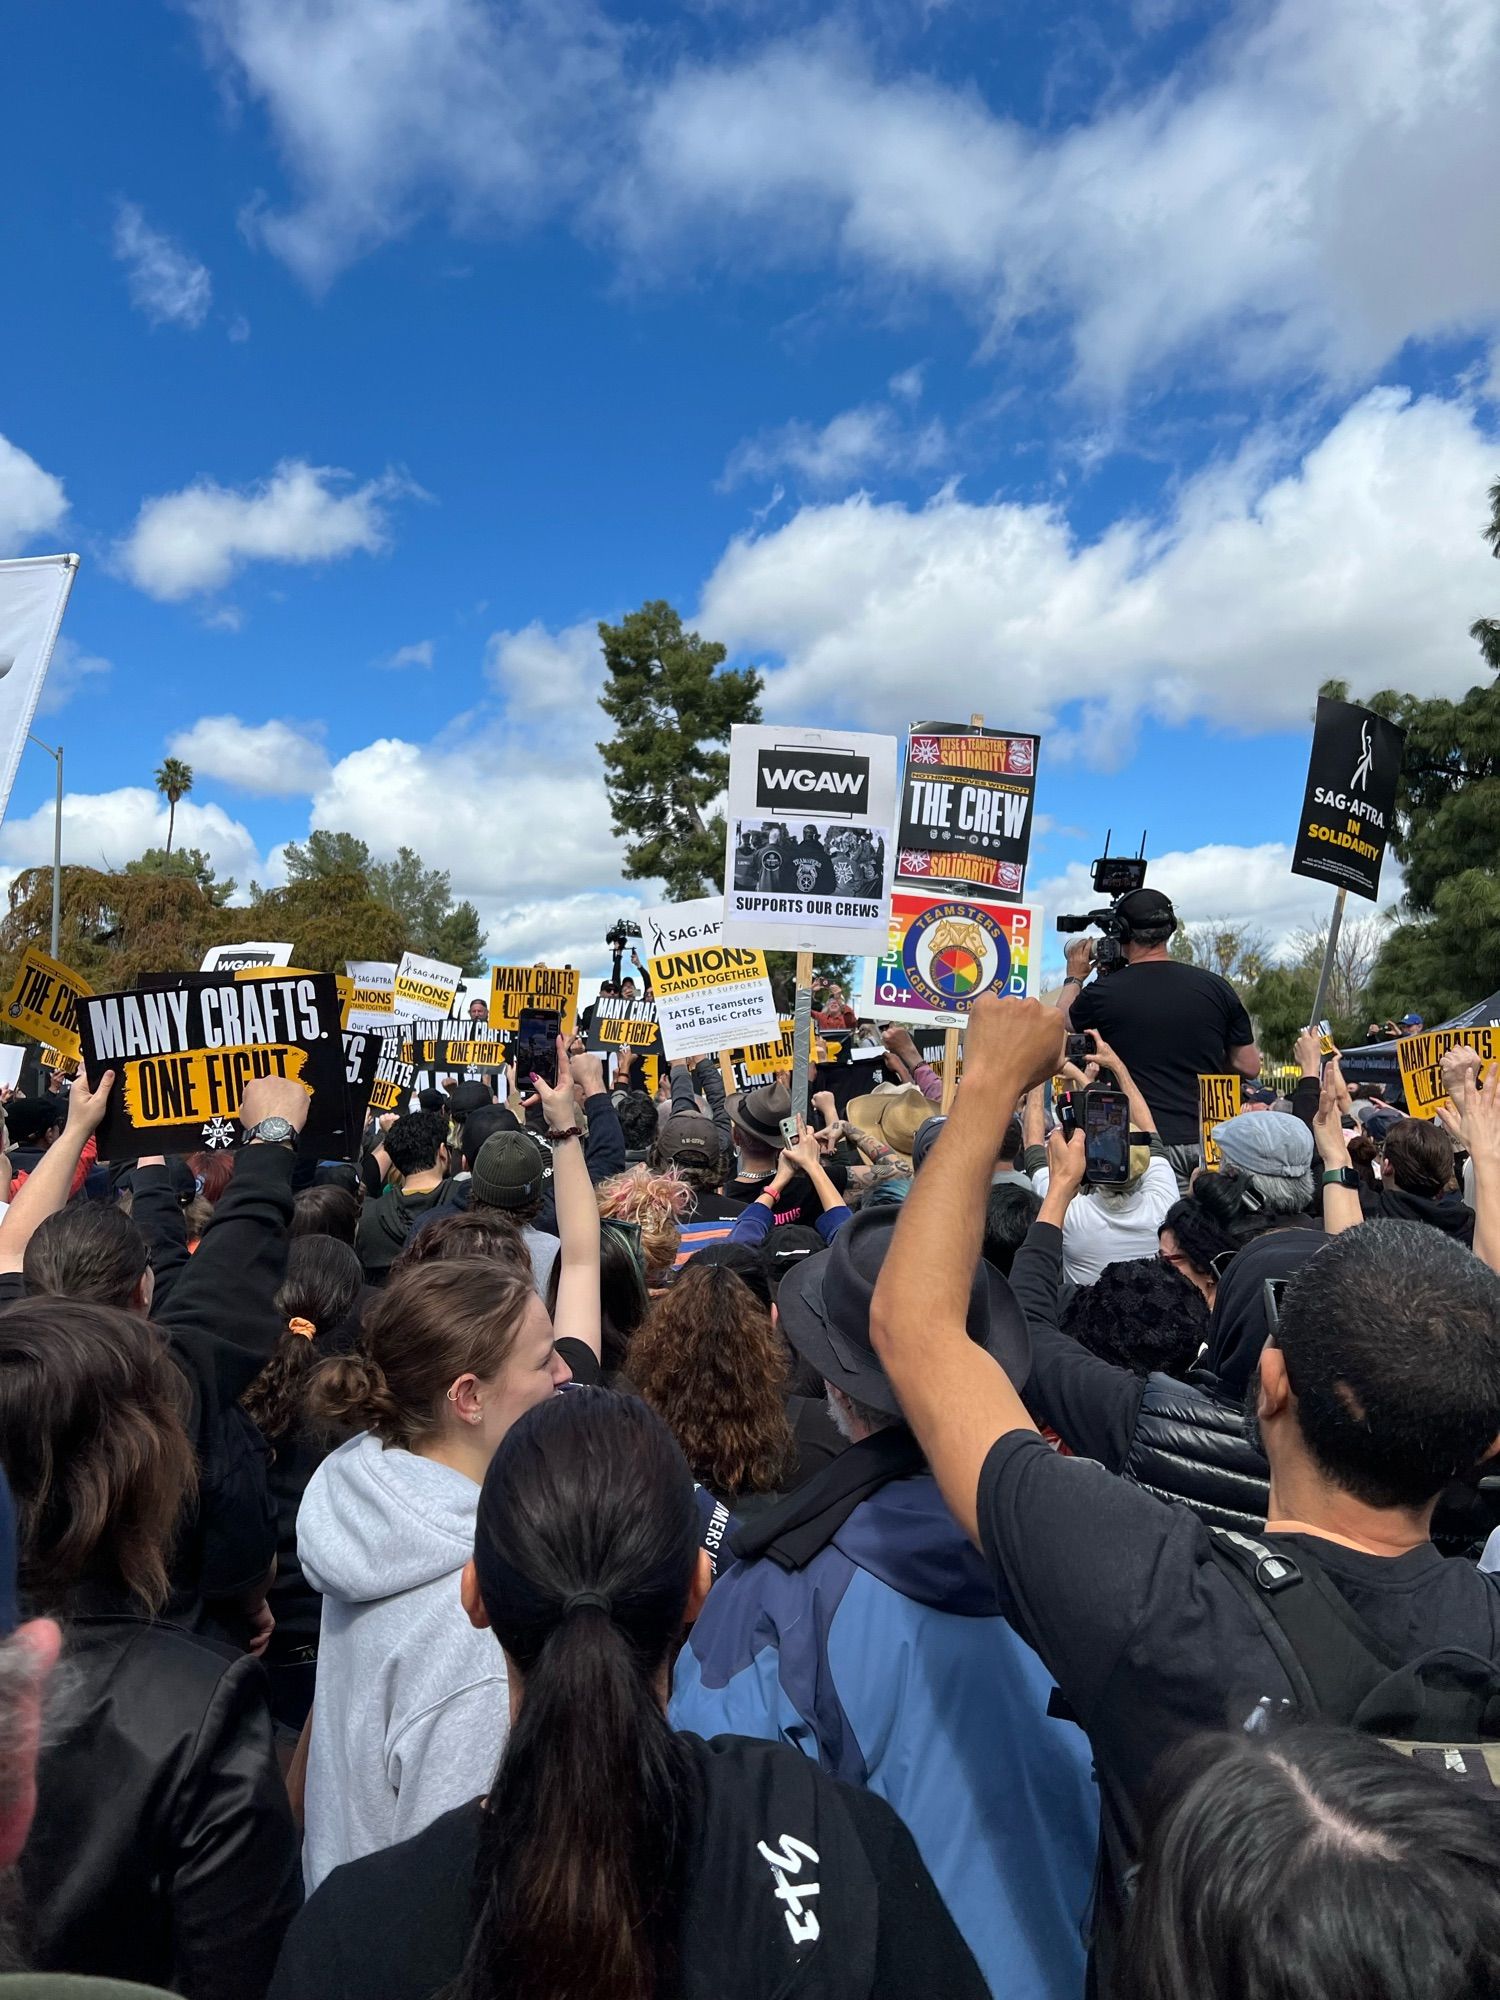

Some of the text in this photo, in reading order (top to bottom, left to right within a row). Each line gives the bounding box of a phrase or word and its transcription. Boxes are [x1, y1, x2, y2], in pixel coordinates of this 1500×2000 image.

[967, 739, 1007, 753] TEAMSTERS
[941, 750, 1007, 772] SOLIDARITY
[761, 767, 865, 795] WGAW
[912, 772, 1030, 795] NOTHING MOVES WITHOUT
[910, 780, 1029, 839] THE CREW
[1347, 818, 1361, 836] IN
[1307, 823, 1379, 862] SOLIDARITY
[930, 856, 997, 884] SOLIDARITY
[736, 896, 880, 919] SUPPORTS OUR CREWS
[915, 905, 1001, 939] TEAMSTERS
[655, 948, 757, 981] UNIONS
[1010, 914, 1028, 1001] PRID
[17, 965, 55, 1015] THE
[398, 978, 450, 1002] UNIONS
[496, 967, 576, 995] MANY CRAFTS.
[660, 967, 760, 994] STAND TOGETHER
[717, 980, 763, 994] SUPPORTS
[906, 966, 947, 1009] LGBTQ+
[365, 1003, 391, 1012] TOGETHER
[396, 990, 416, 1000] STAND
[416, 993, 447, 1009] TOGETHER
[596, 997, 630, 1020] MANY
[668, 995, 764, 1021] IATSE, Teamsters
[88, 979, 329, 1061] MANY CRAFTS.
[394, 1008, 409, 1018] Our
[675, 1018, 696, 1031] and
[698, 1012, 728, 1030] Basic
[730, 1007, 762, 1022] Crafts
[351, 1022, 364, 1030] Our
[441, 1020, 473, 1042] MANY
[604, 1020, 625, 1041] ONE
[451, 1042, 470, 1062] ONE
[1400, 1035, 1431, 1074] MANY
[138, 1057, 199, 1121] ONE
